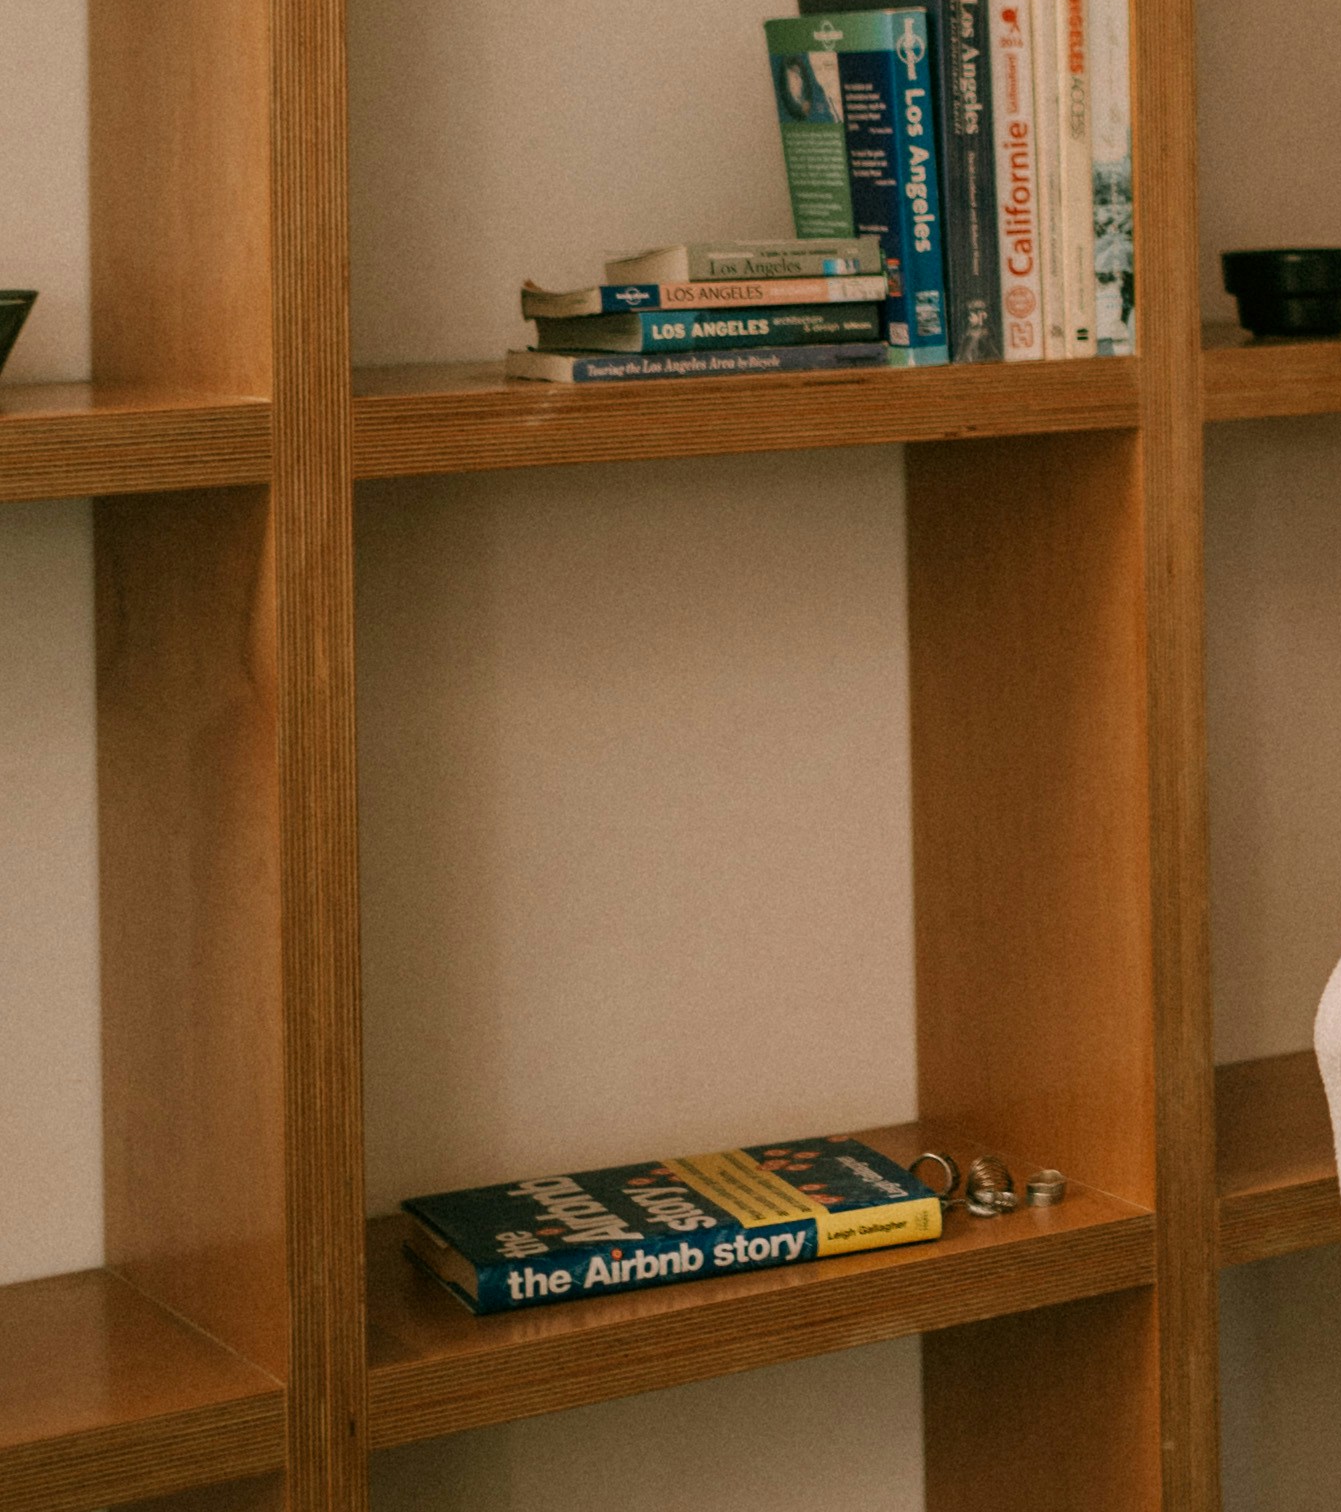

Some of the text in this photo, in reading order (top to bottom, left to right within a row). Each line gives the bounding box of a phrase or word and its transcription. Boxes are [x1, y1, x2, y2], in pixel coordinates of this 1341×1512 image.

[959, 42, 984, 135] Angeles
[905, 88, 925, 137] Los
[905, 144, 936, 253] Angeles
[1004, 121, 1034, 277] Californie
[708, 257, 802, 278] Los Angeles
[665, 286, 695, 302] LOS
[700, 284, 764, 301] ANGELES
[652, 319, 770, 340] LOS ANGELES
[642, 359, 662, 373] Los
[664, 357, 707, 375] Angeles
[709, 356, 735, 370] Area
[507, 1176, 645, 1243] Airbnb
[622, 1186, 718, 1232] story
[495, 1230, 550, 1259] the
[827, 1228, 856, 1241] Leigh
[507, 1230, 806, 1300] the Airbnb story
